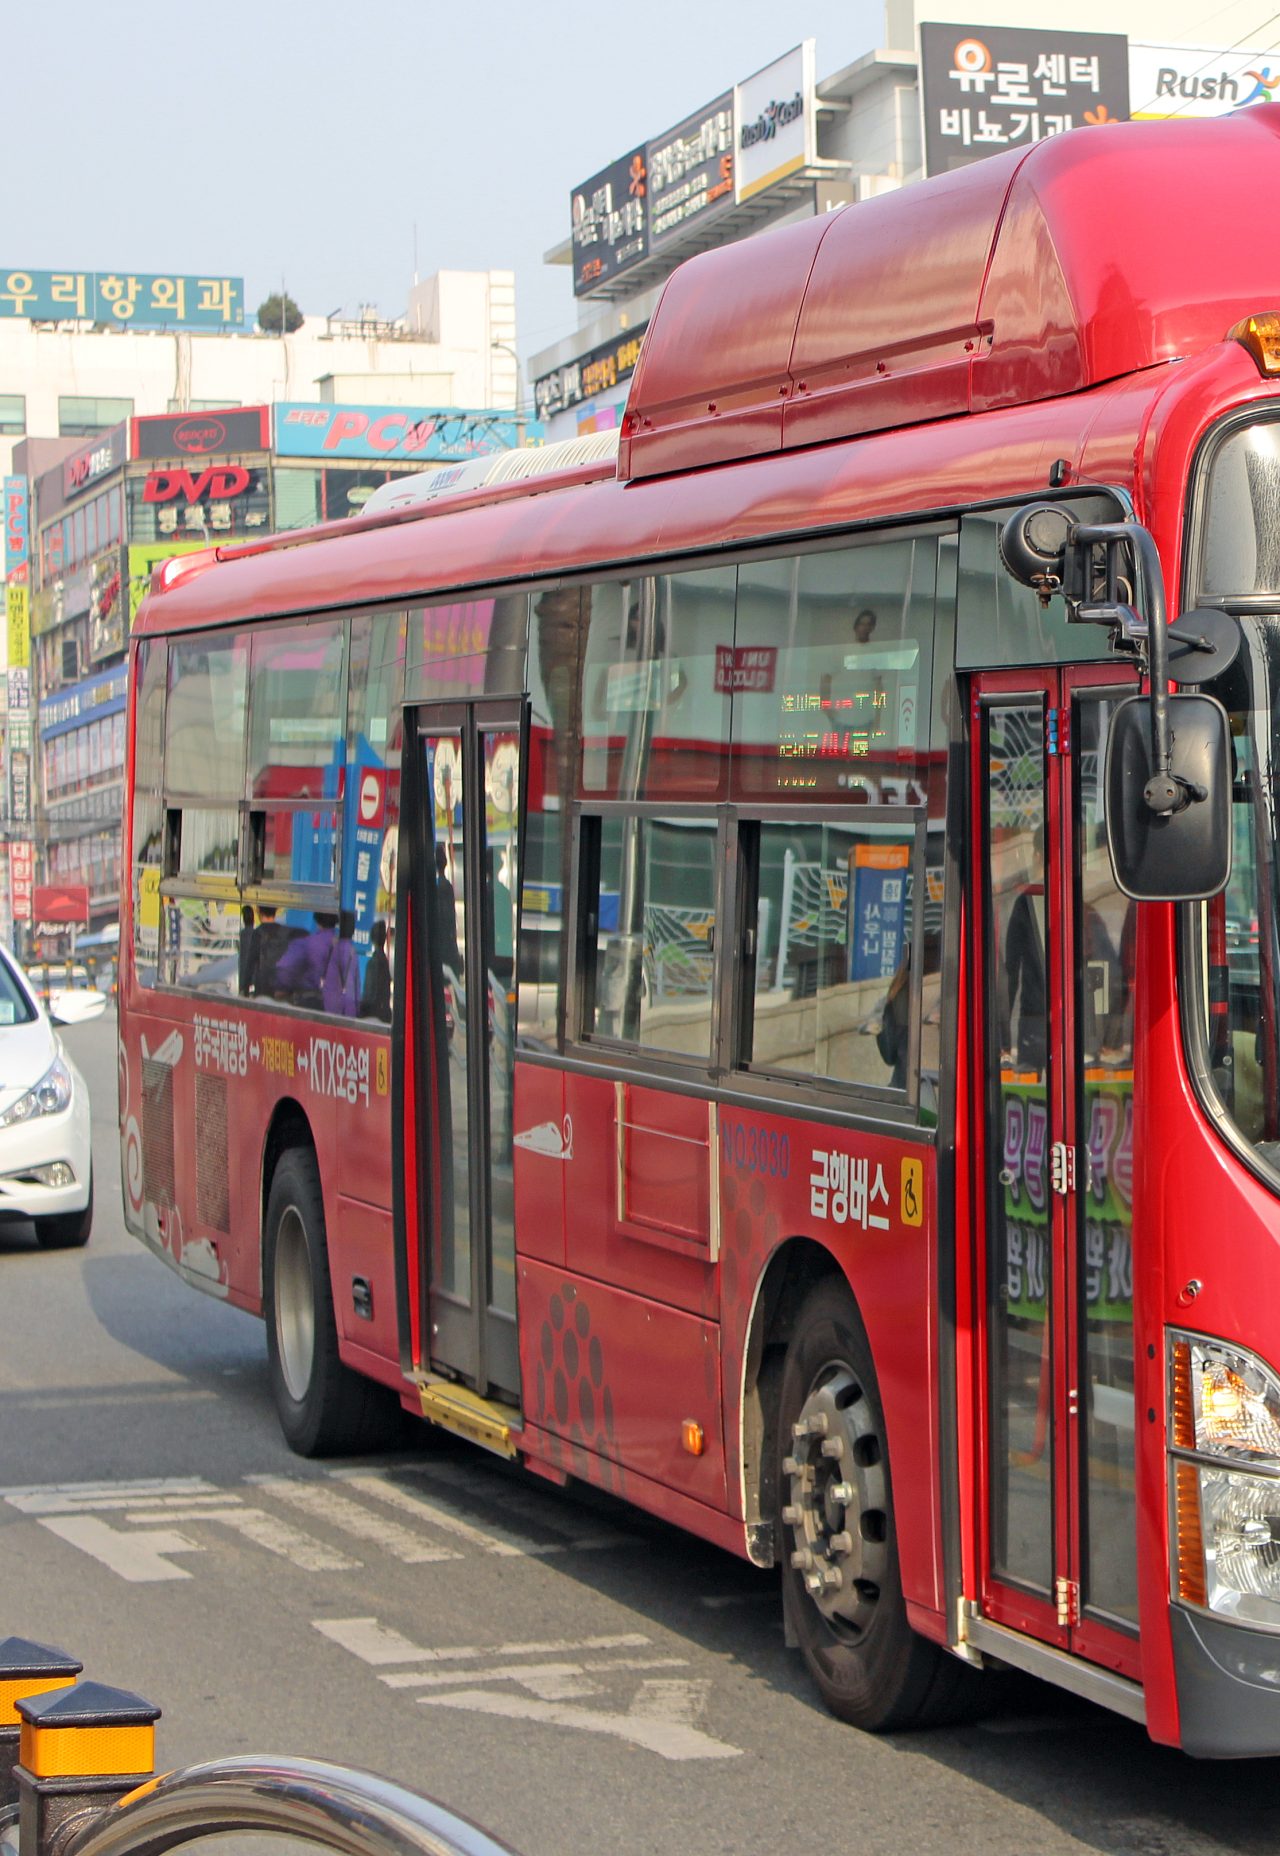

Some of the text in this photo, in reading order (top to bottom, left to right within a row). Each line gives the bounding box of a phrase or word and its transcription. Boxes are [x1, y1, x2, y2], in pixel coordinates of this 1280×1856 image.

[949, 40, 1100, 106] 유로센터
[1156, 68, 1238, 102] Rush
[0, 272, 238, 321] 우리항외과
[143, 466, 251, 505] DVD
[193, 1013, 248, 1076] 청주국제공항
[309, 1037, 370, 1108] KTX오송역
[810, 1149, 890, 1231] 급행버스
